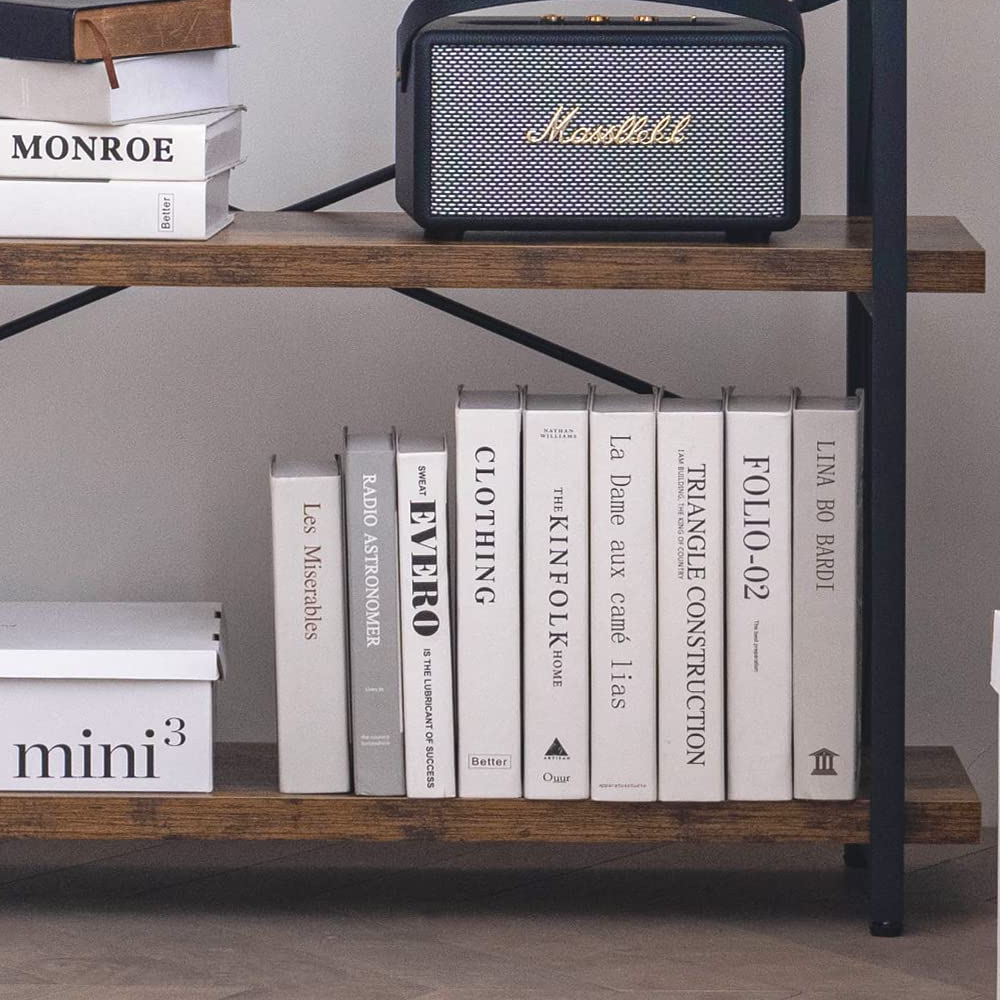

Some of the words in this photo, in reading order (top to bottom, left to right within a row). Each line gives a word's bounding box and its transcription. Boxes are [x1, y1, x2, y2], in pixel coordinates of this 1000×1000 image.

[11, 134, 174, 163] MONROE
[160, 197, 171, 230] Better
[609, 435, 632, 461] La
[678, 452, 685, 465] AM
[816, 440, 836, 487] LINA
[362, 473, 378, 527] RADIO
[417, 465, 427, 497] SWEAT
[553, 487, 564, 513] THE
[610, 474, 632, 526] Dame
[303, 503, 321, 534] Les
[474, 446, 496, 605] CLOTHING
[677, 502, 685, 516] THE
[677, 517, 685, 535] KING
[686, 463, 707, 581] TRIANGLE
[742, 455, 771, 600] FOLIO-02
[816, 499, 836, 523] BO
[610, 540, 626, 578] aux
[677, 535, 685, 546] OF
[409, 500, 440, 637] EVERO
[548, 514, 569, 649] KINFOLK
[677, 546, 685, 580] COUNTRY
[815, 534, 835, 592] BARDI
[303, 545, 323, 641] Miserables
[363, 532, 381, 648] ASTRONOMER
[610, 592, 632, 644] camé
[422, 648, 432, 658] IS
[423, 658, 432, 677] THE
[552, 650, 563, 688] HOME
[610, 660, 633, 709] lias
[686, 585, 706, 767] CONSTRUCTION
[423, 678, 434, 730] LUBRICANT
[425, 731, 434, 744] OF
[425, 745, 435, 789] SUCCESS
[471, 756, 508, 768] Better
